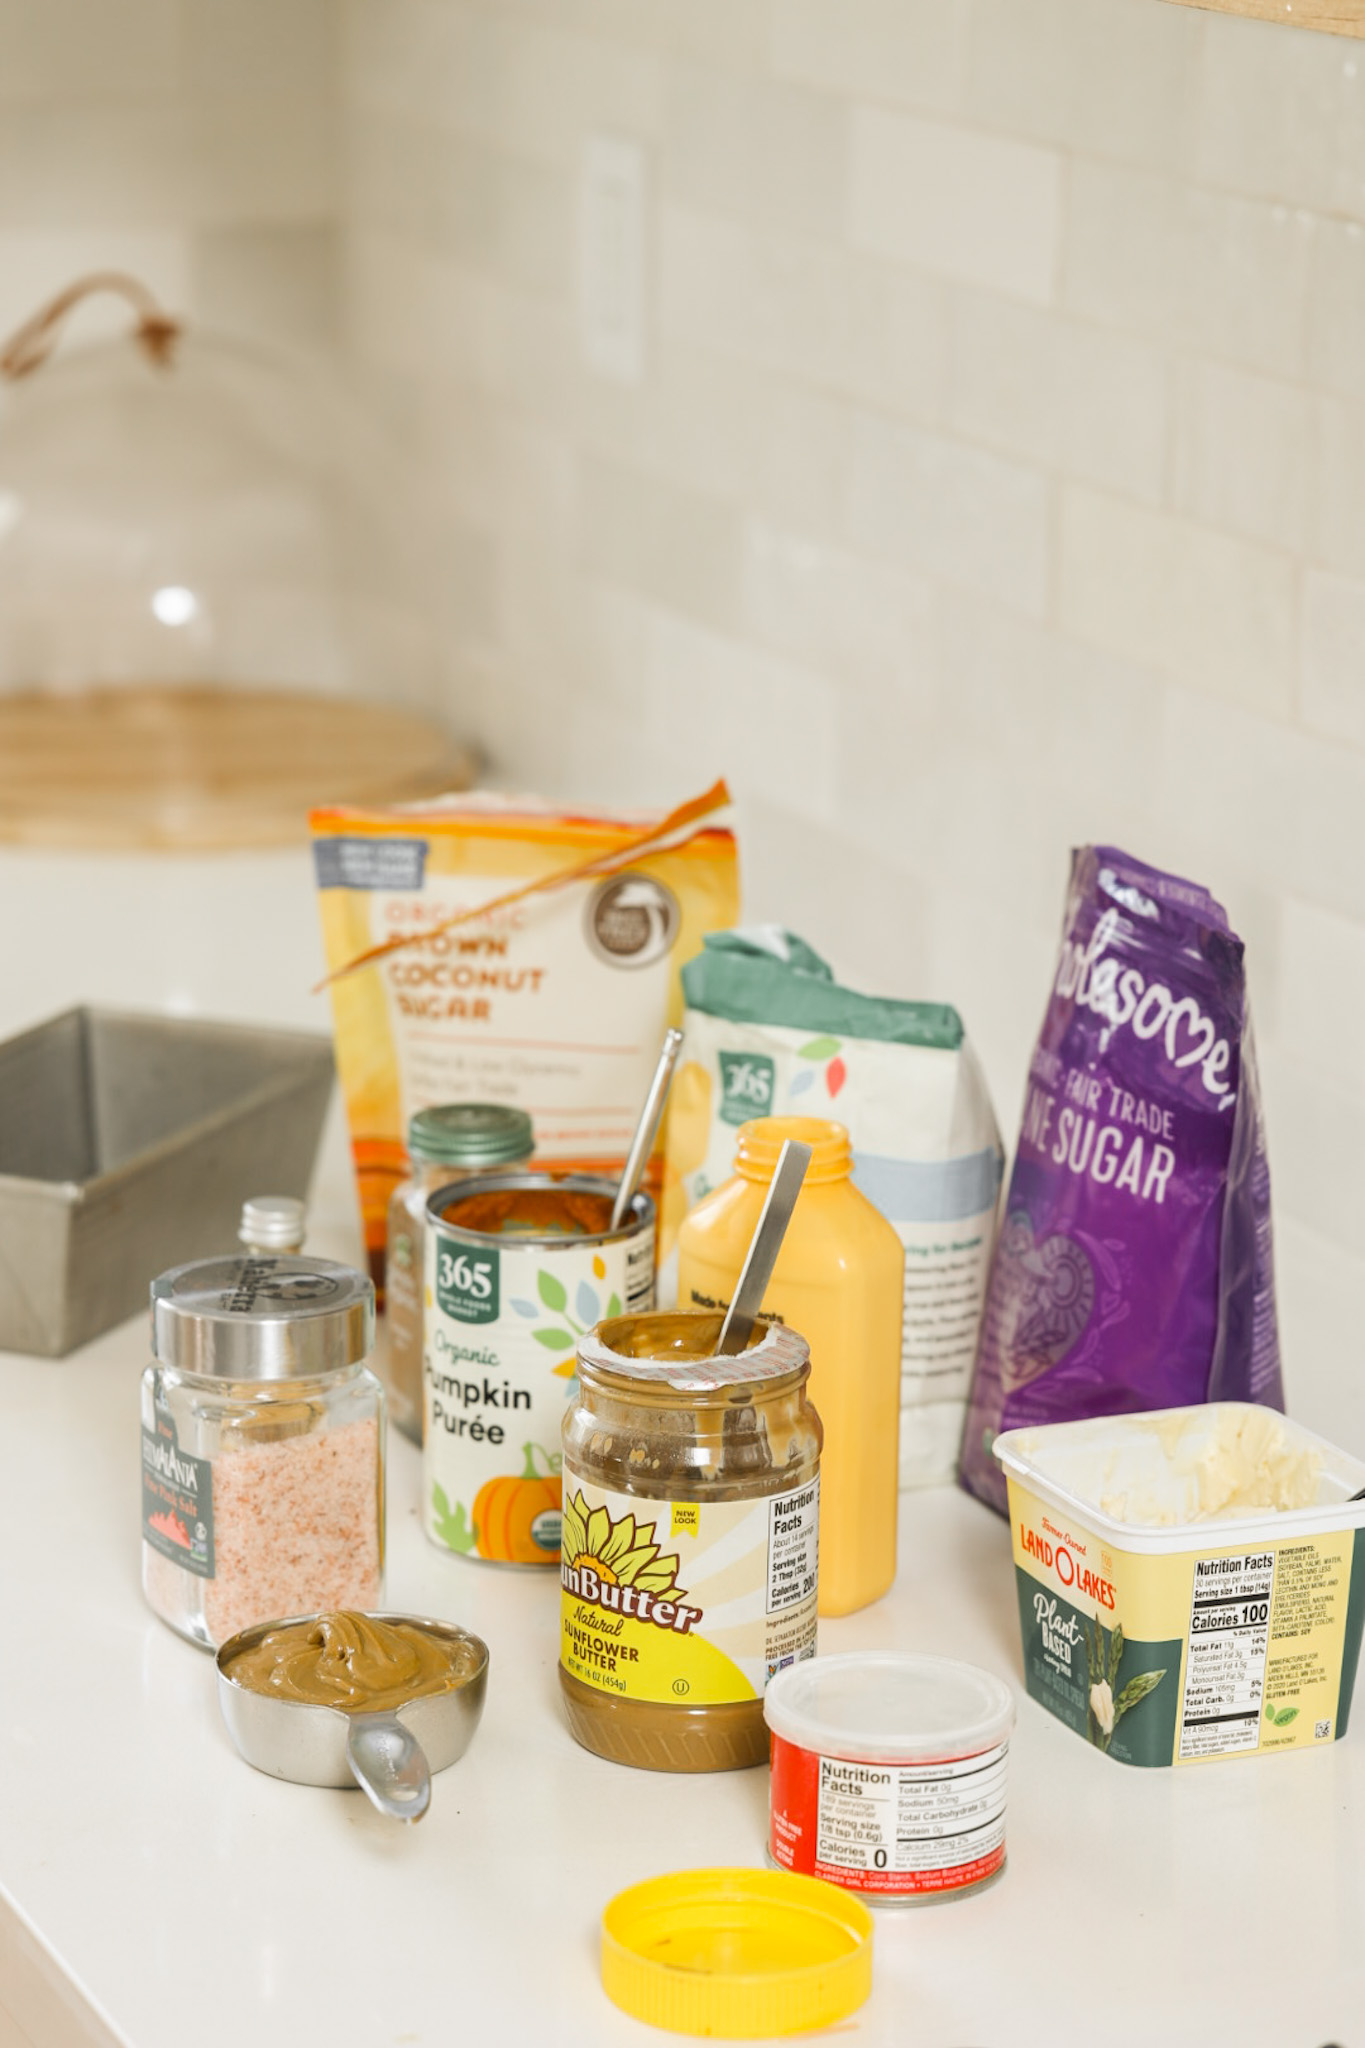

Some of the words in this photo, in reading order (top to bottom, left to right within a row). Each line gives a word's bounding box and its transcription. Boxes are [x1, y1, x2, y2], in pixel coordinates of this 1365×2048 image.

[388, 961, 546, 994] COCONUT
[1063, 1068, 1102, 1111] FAIR
[1107, 1086, 1175, 1141] TRADE
[1052, 1107, 1176, 1204] SUGAR
[438, 1252, 493, 1299] 365
[434, 1329, 499, 1367] Organic
[432, 1400, 505, 1445] Purée
[774, 1489, 815, 1517] Nutrition
[674, 1517, 697, 1525] LOOK
[676, 1510, 696, 1518] NEW
[774, 1514, 803, 1536] Facts
[773, 1536, 791, 1549] About
[773, 1550, 783, 1561] per
[772, 1557, 796, 1573] Serving
[1020, 1523, 1053, 1568] LAND
[1055, 1546, 1075, 1586] O
[1076, 1562, 1116, 1610] LAKES
[1196, 1559, 1242, 1577] Nutrition
[1244, 1554, 1273, 1571] Facts
[1204, 1577, 1231, 1589] servings
[1231, 1575, 1242, 1586] per
[1243, 1571, 1272, 1582] container
[1299, 1582, 1310, 1591] AND
[1328, 1578, 1339, 1586] AND
[771, 1581, 799, 1599] Calories
[1194, 1587, 1219, 1599] Serving
[1220, 1587, 1233, 1596] size
[1239, 1584, 1255, 1595] tbsp
[1255, 1581, 1271, 1593] (14g)
[771, 1598, 782, 1609] per
[573, 1605, 624, 1637] Natural
[1192, 1611, 1239, 1630] Calories
[1242, 1603, 1268, 1624] 100
[564, 1618, 639, 1662] SUNFLOWER
[1238, 1628, 1252, 1637] Daily
[1253, 1627, 1267, 1635] Value
[1042, 1620, 1072, 1665] BASED
[1190, 1643, 1209, 1653] Total
[1210, 1642, 1222, 1650] Fat
[573, 1642, 617, 1672] BUTTER
[1193, 1653, 1223, 1663] Saturated
[1224, 1651, 1234, 1660] Fat
[592, 1671, 601, 1682] OZ
[602, 1674, 627, 1692] (454g)
[1185, 1698, 1204, 1707] Total
[1205, 1696, 1225, 1705] Carb.
[1249, 1691, 1261, 1699] 0%
[1186, 1687, 1214, 1696] Sodium
[1184, 1708, 1211, 1718] Protein
[1211, 1707, 1221, 1717] 0g
[1274, 1708, 1298, 1725] Vegan
[1183, 1727, 1192, 1735] Vit
[1192, 1726, 1198, 1734] A
[822, 1762, 891, 1785] Nutrition
[821, 1776, 863, 1796] Facts
[899, 1786, 921, 1795] Total
[940, 1784, 951, 1793] 0g
[835, 1806, 876, 1818] container
[838, 1797, 875, 1811] servings
[898, 1799, 934, 1809] Sodium
[899, 1813, 921, 1822] Total
[922, 1804, 978, 1821] Carbohydrate
[821, 1812, 858, 1830] Serving
[861, 1821, 881, 1831] size
[820, 1823, 833, 1835] 1/8
[835, 1827, 851, 1839] tsp
[853, 1830, 882, 1843] (0.6g)
[896, 1827, 930, 1836] Protein
[820, 1839, 866, 1858] Calories
[874, 1848, 888, 1869] 0
[896, 1841, 931, 1852] Calcium
[819, 1851, 832, 1861] per
[835, 1855, 867, 1868] serving
[863, 1880, 916, 1890] CORPORATION
